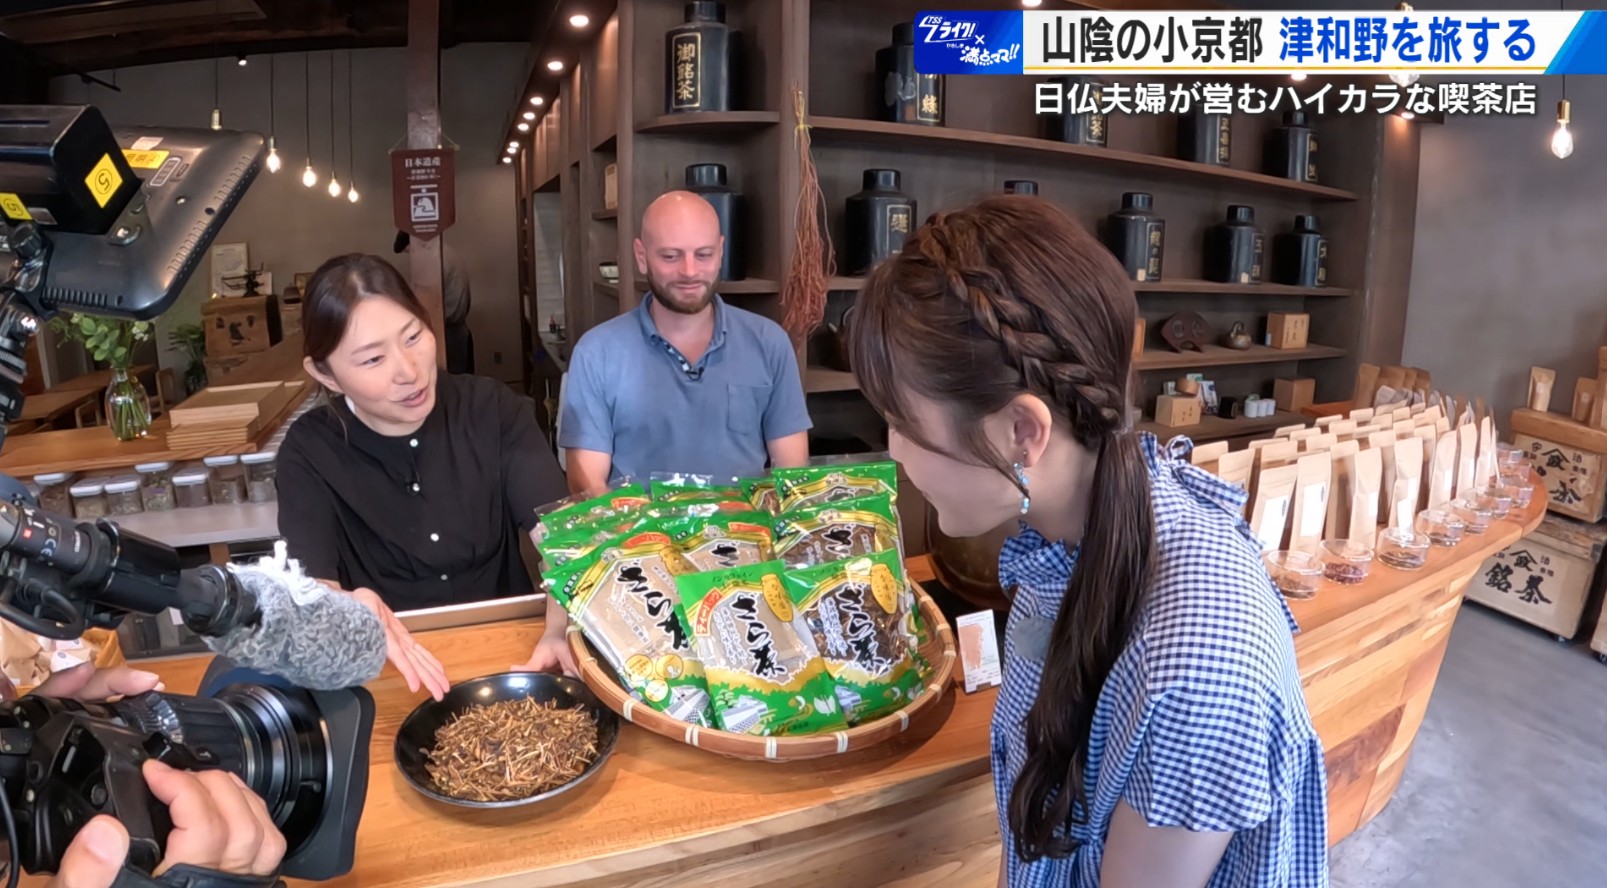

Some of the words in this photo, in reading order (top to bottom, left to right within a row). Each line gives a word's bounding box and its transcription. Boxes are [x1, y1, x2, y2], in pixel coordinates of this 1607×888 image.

[677, 43, 695, 100] 御銘茶
[405, 156, 441, 168] 日本遺産
[1485, 562, 1553, 605] 銘茶
[731, 592, 786, 677] ざら茶
